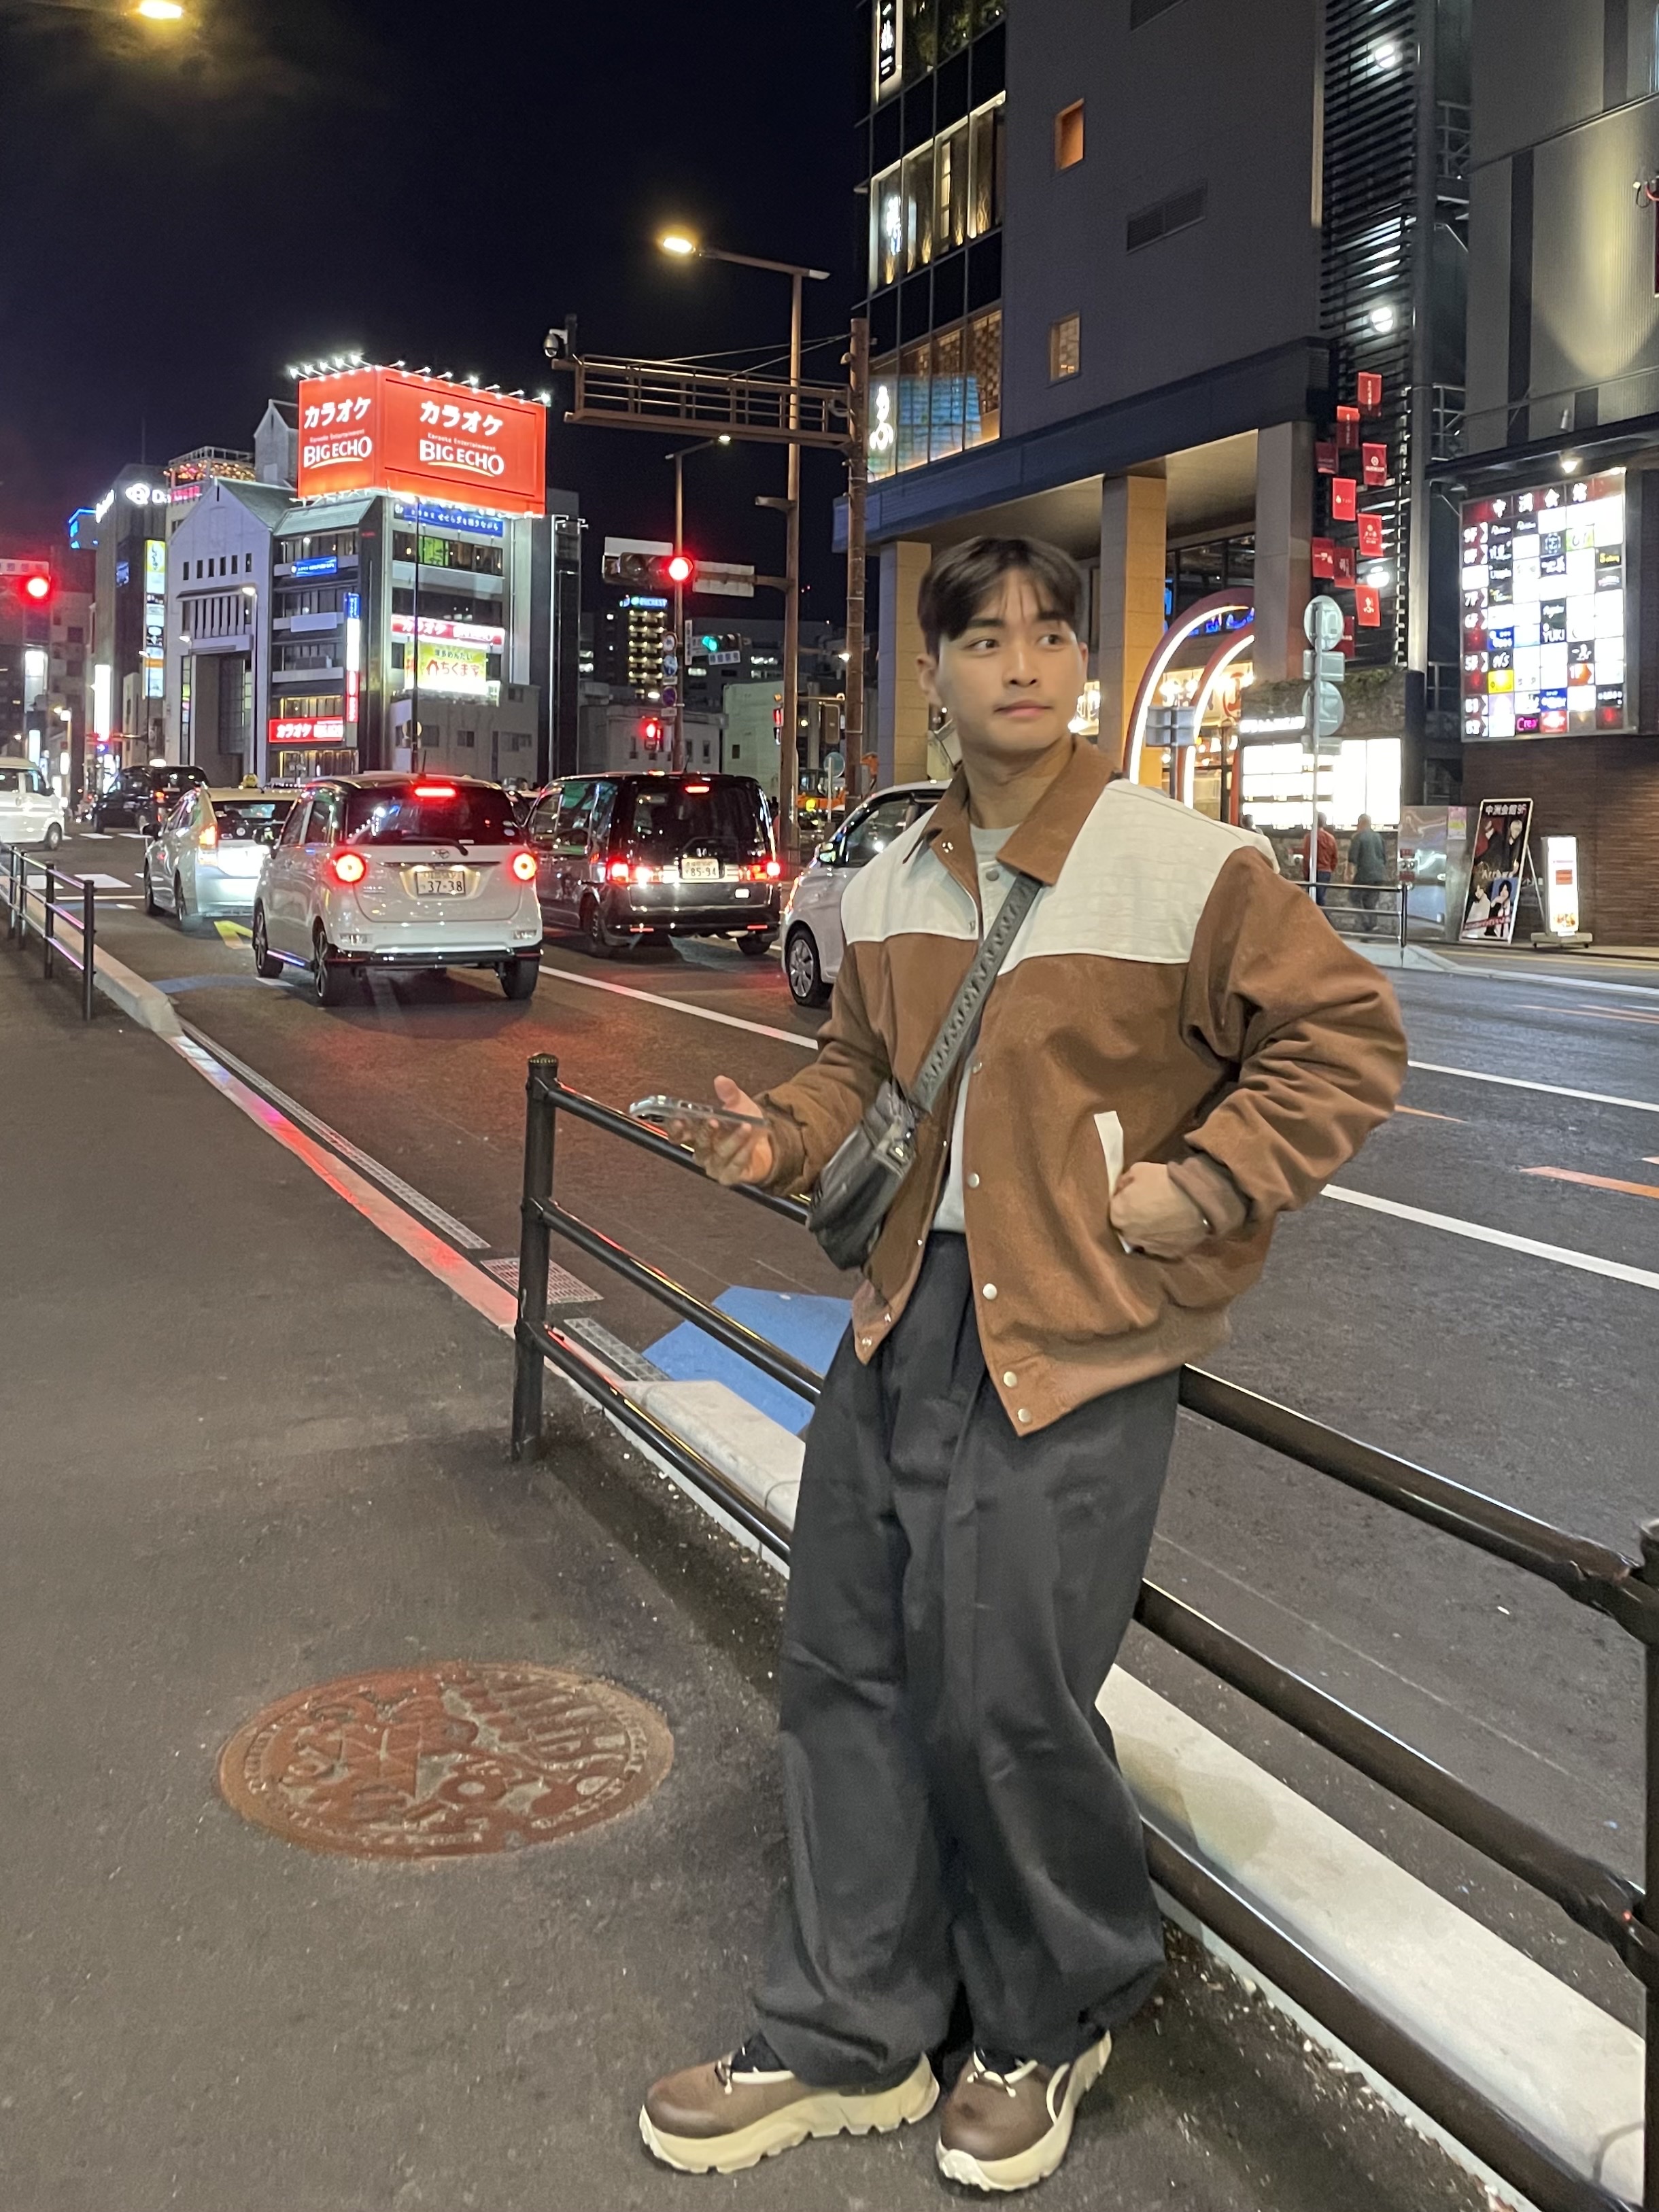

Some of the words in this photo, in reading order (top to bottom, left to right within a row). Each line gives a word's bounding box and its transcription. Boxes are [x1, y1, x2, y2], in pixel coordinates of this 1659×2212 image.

[303, 396, 371, 429] カラオケ
[420, 400, 503, 436] カラオケ
[303, 444, 330, 468] BIG
[331, 436, 373, 457] ECHO
[420, 438, 454, 462] BIG
[456, 448, 504, 475] ECHO
[427, 880, 463, 893] 37-38
